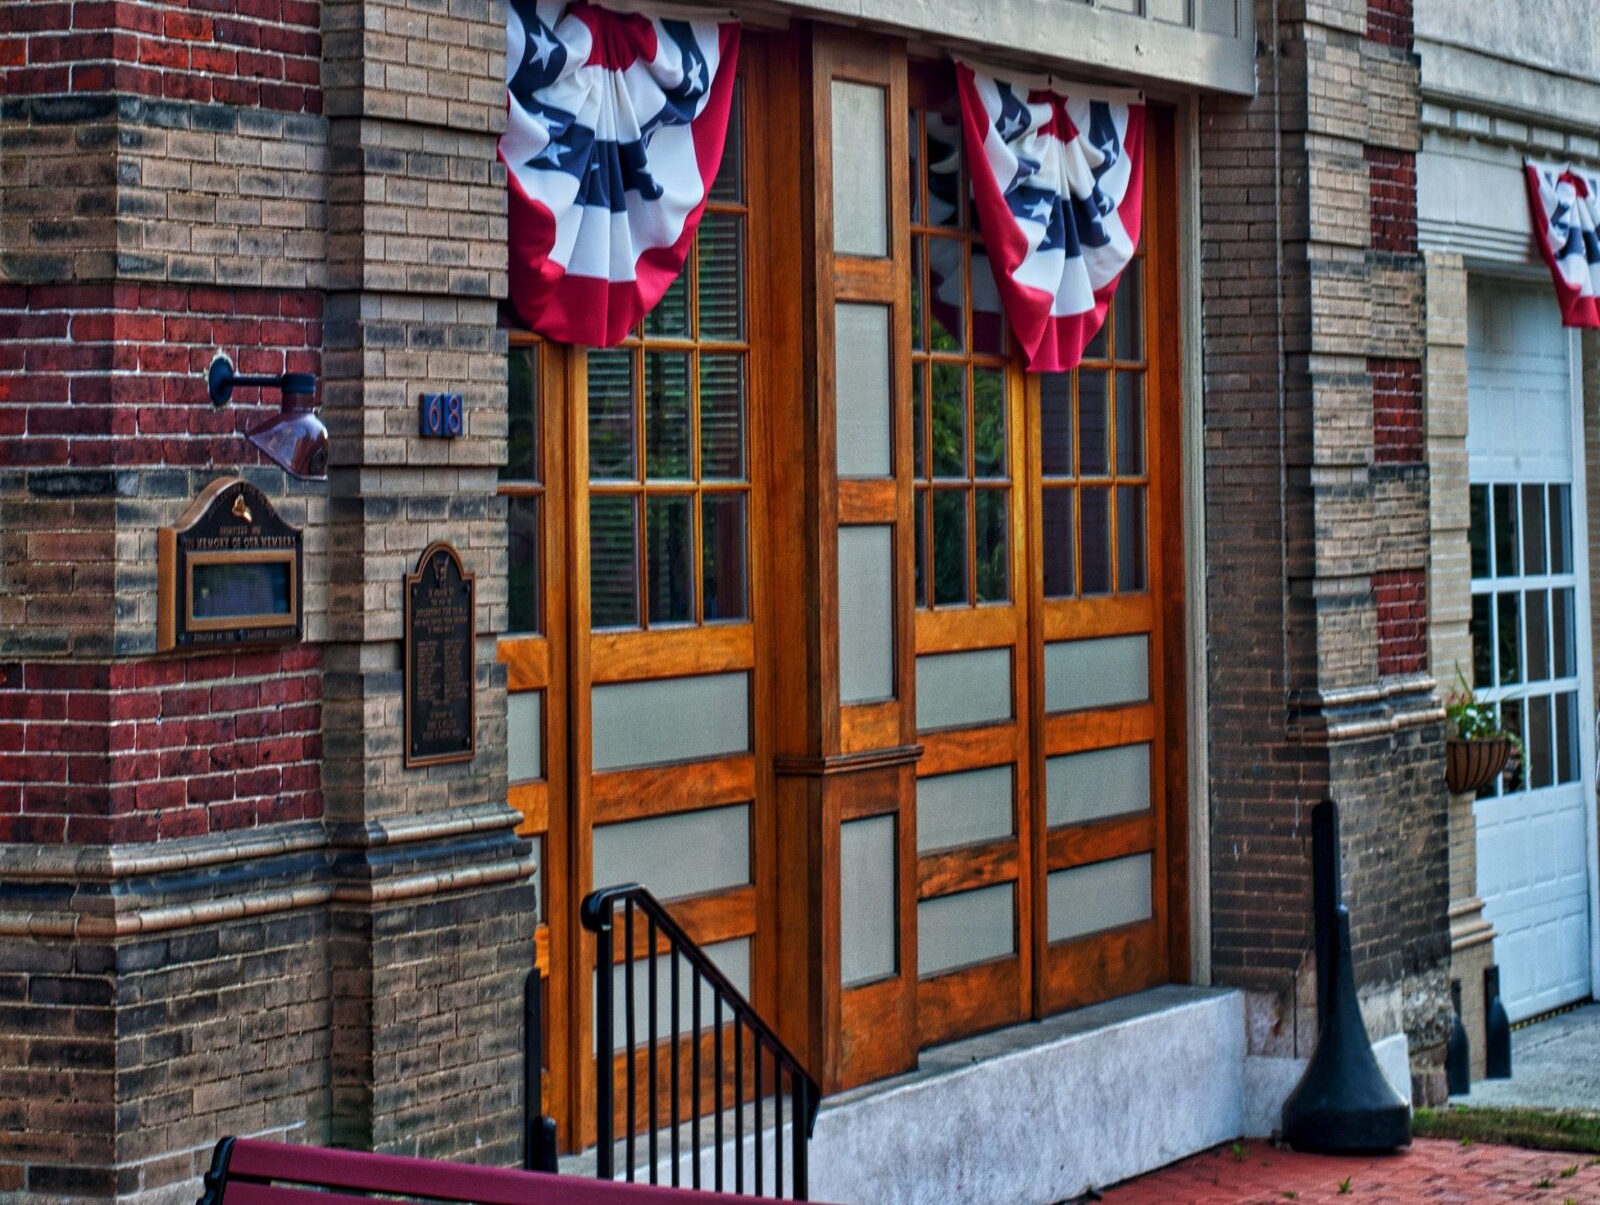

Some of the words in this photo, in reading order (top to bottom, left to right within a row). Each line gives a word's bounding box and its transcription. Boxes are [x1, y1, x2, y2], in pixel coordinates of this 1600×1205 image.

[428, 393, 461, 434] 68
[196, 537, 229, 549] MEMORY
[231, 537, 241, 549] OF
[243, 536, 260, 548] OUR
[261, 535, 296, 547] MEMBERS
